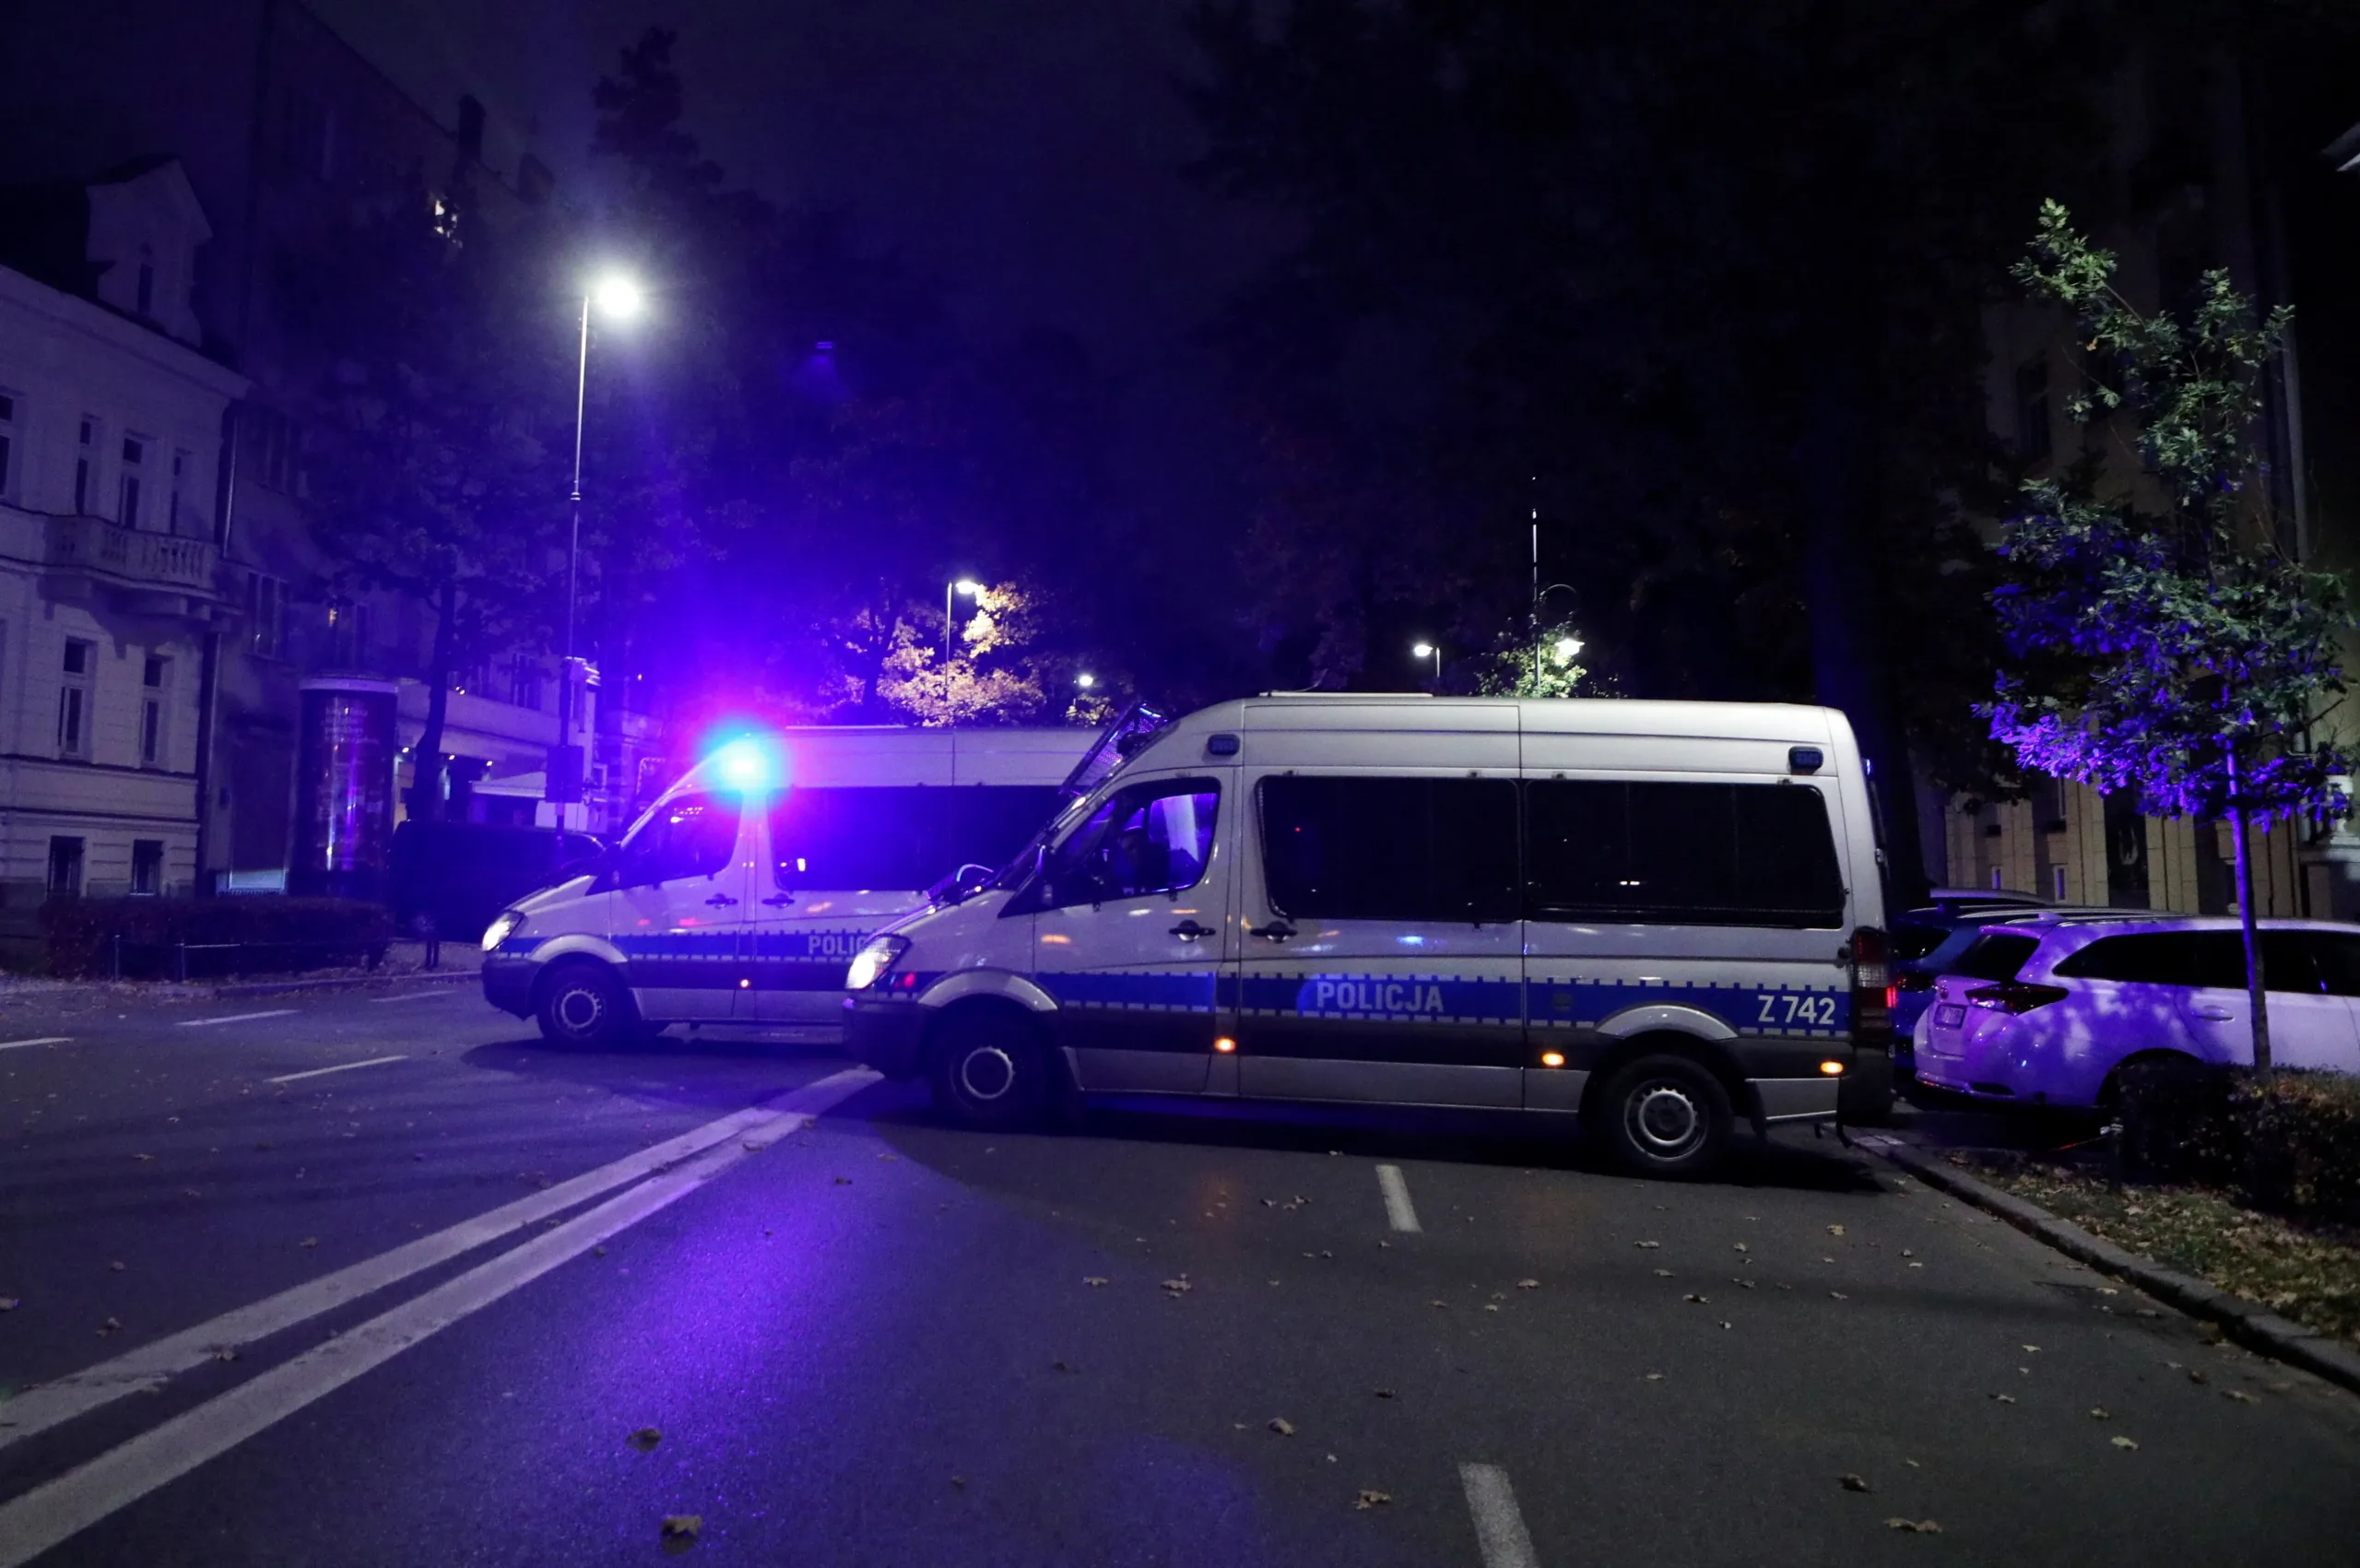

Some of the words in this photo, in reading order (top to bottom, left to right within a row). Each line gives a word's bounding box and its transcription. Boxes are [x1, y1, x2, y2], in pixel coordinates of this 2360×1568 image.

[1316, 981, 1444, 1012] POLICJA
[1758, 995, 1776, 1022] Z
[1782, 996, 1835, 1025] 742
